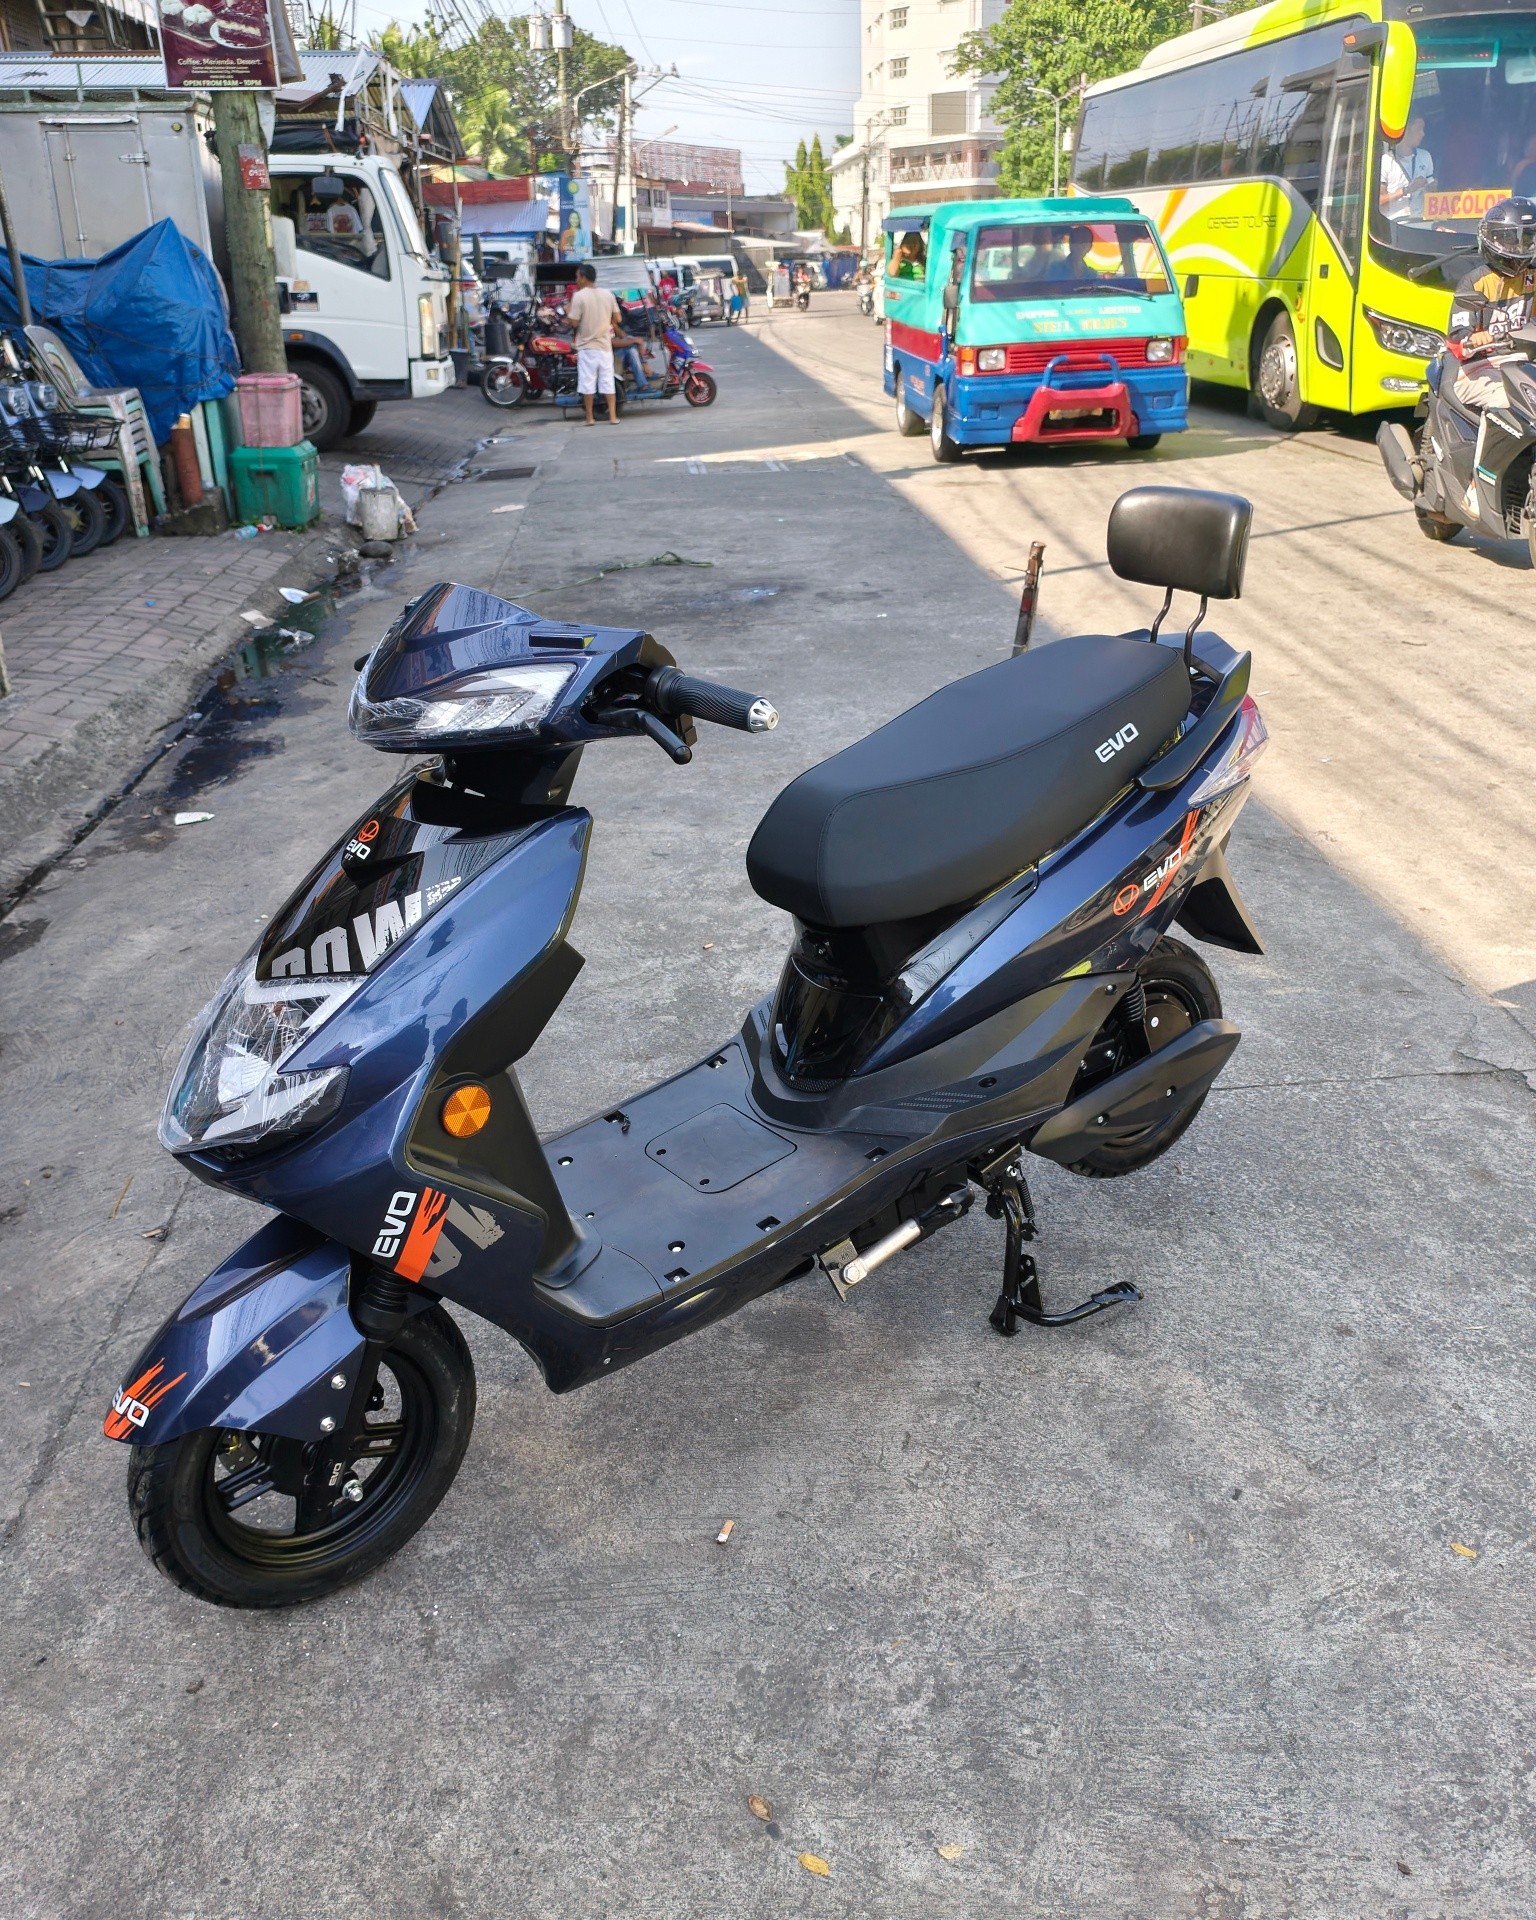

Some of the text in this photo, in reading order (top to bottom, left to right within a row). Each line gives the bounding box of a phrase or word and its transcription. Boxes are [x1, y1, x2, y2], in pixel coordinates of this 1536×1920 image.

[1094, 722, 1140, 763] EVO
[345, 838, 371, 860] EVO
[1143, 847, 1183, 892] EVO
[371, 1190, 418, 1258] EVO
[112, 1383, 150, 1428] EVO
[328, 1462, 343, 1487] EVO
